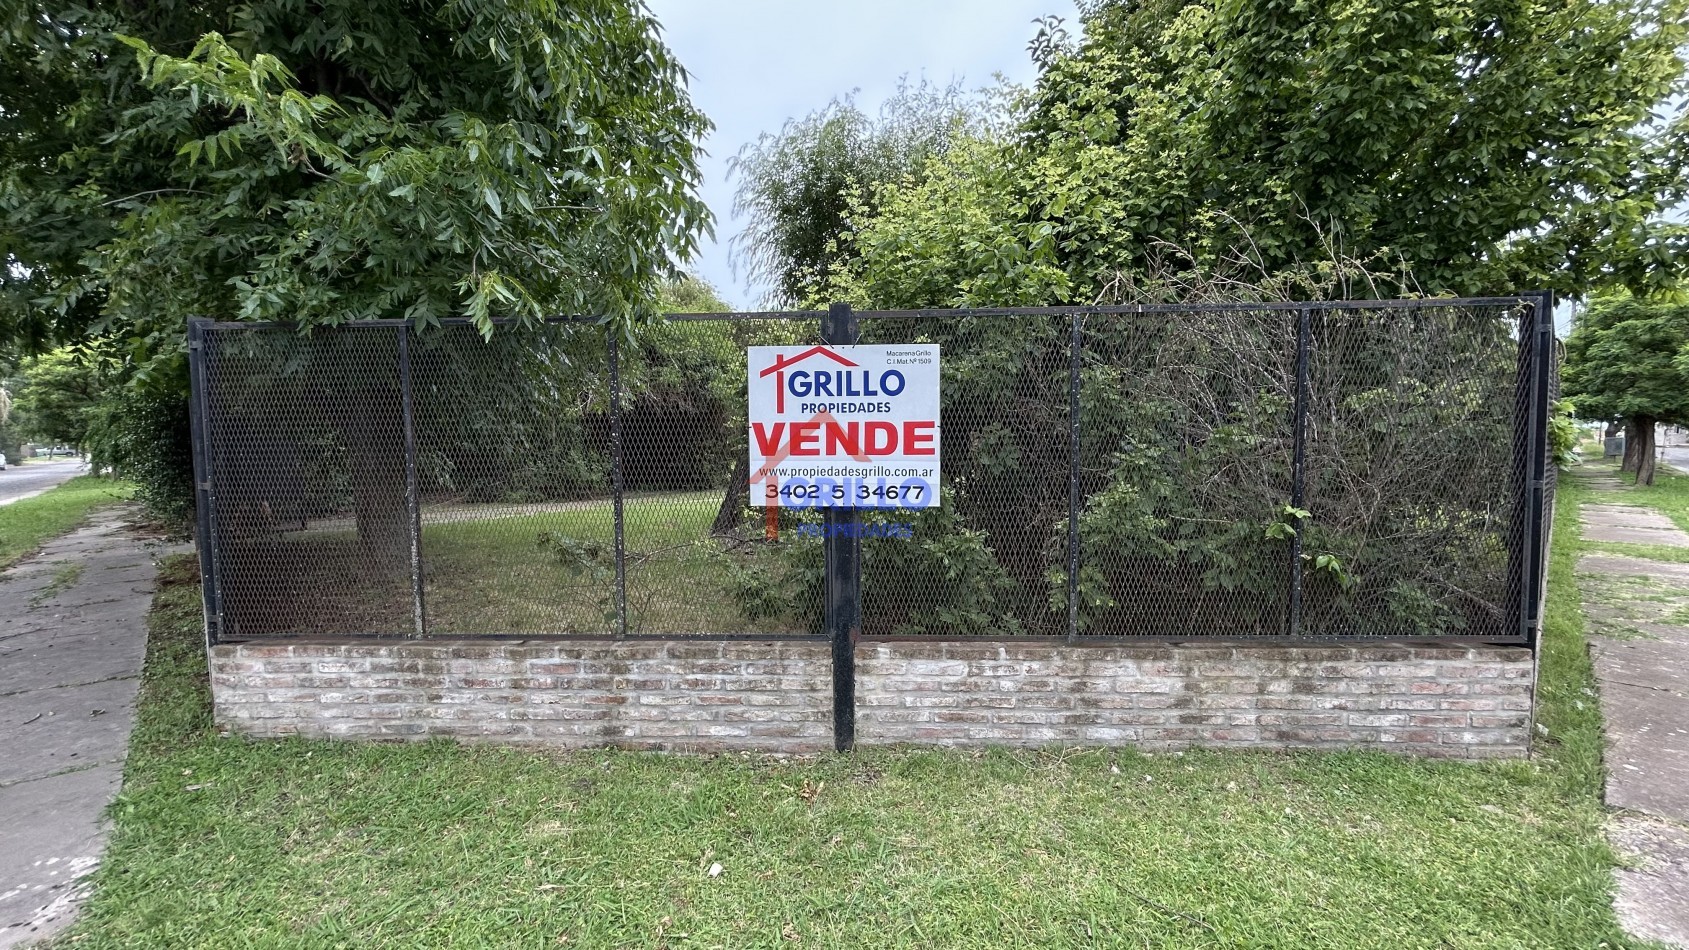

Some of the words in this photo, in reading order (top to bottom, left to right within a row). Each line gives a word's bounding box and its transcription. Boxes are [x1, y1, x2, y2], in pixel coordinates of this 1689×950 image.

[788, 369, 906, 397] GRILLO
[801, 402, 891, 414] PROPIEDADES
[751, 421, 936, 456] VENDE
[759, 466, 934, 479] www.propiedadesgrillo.com.ar
[765, 484, 820, 499] 3402
[831, 485, 845, 499] 5
[856, 485, 925, 500] 34677
